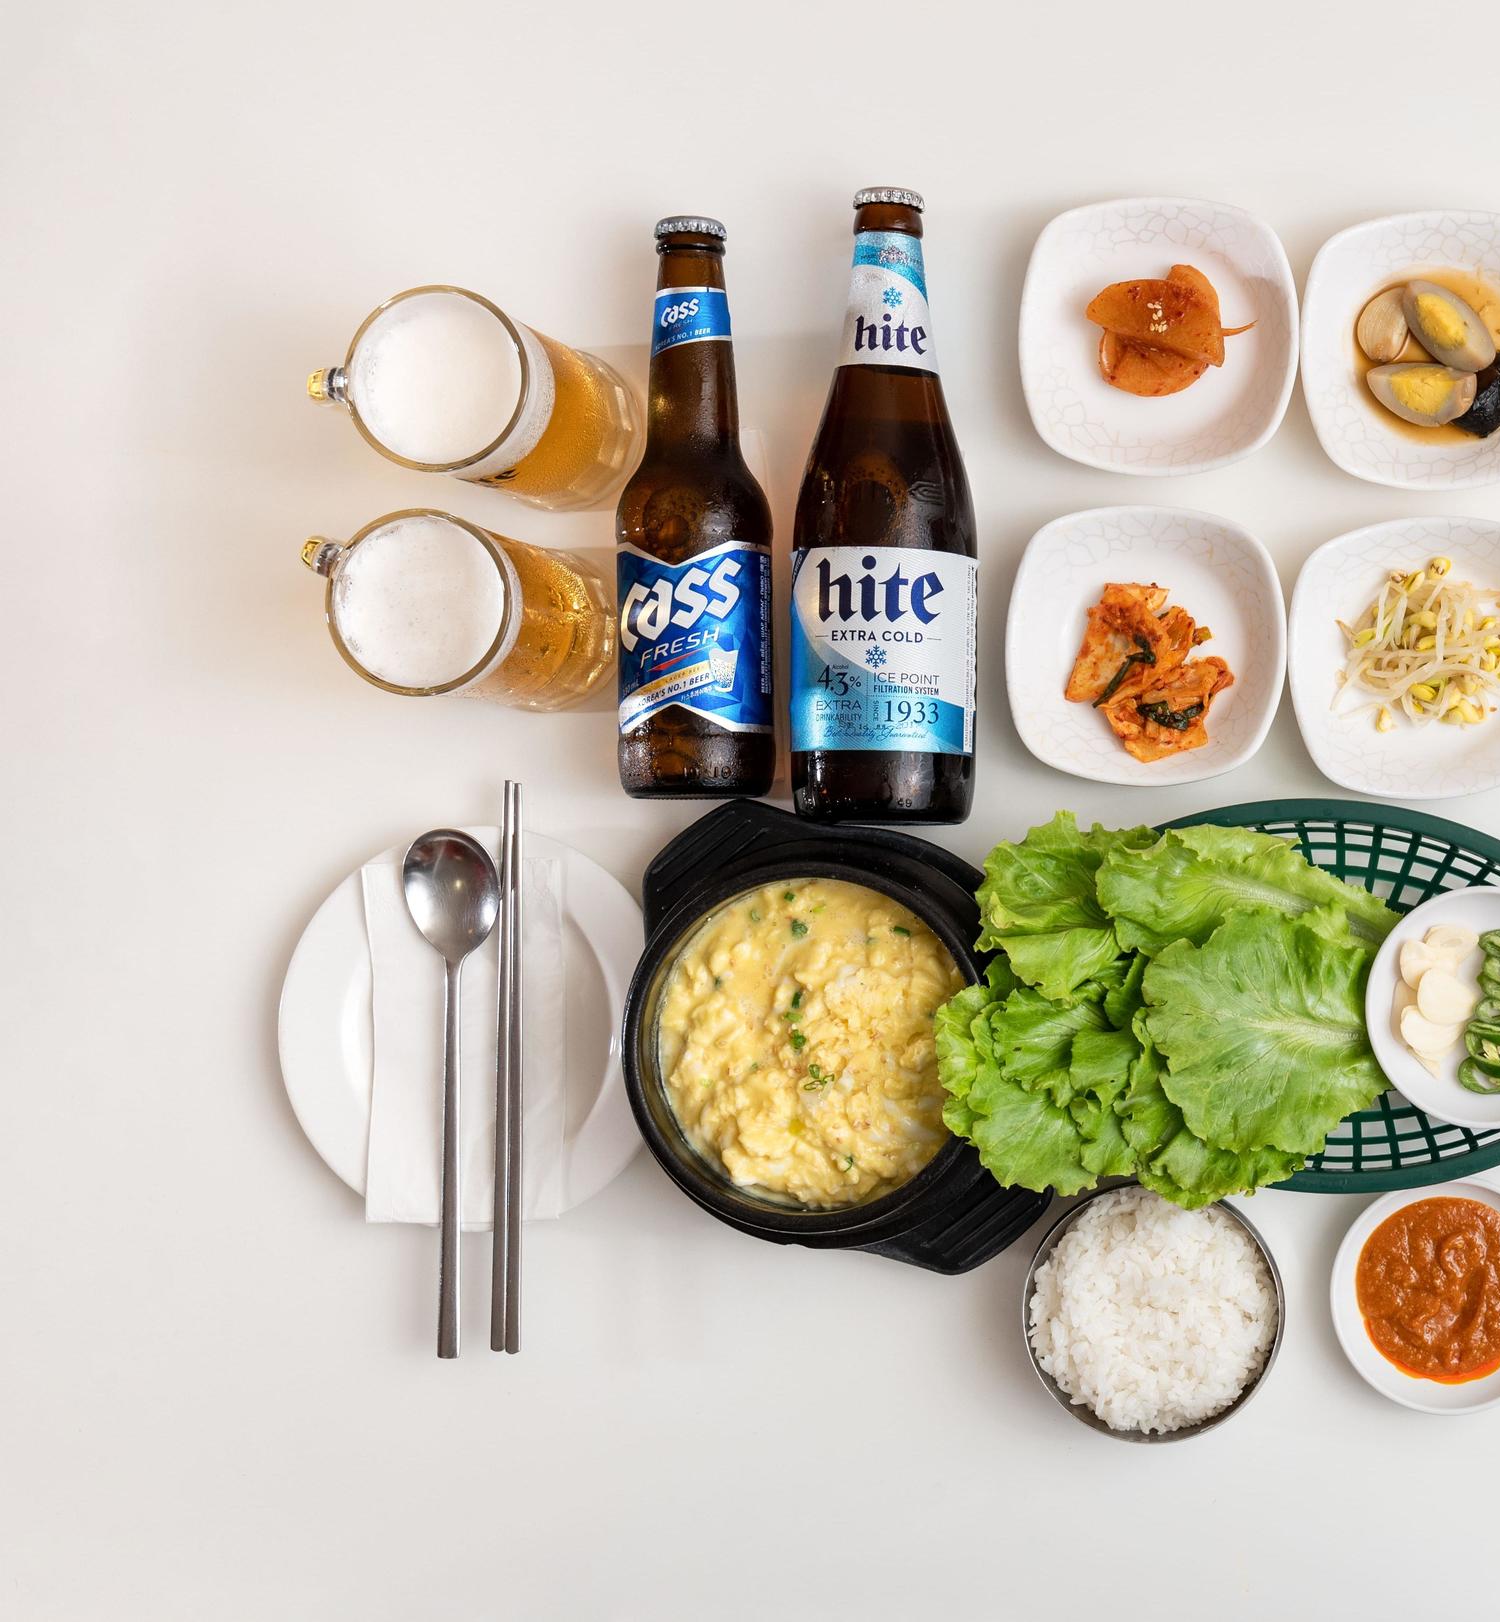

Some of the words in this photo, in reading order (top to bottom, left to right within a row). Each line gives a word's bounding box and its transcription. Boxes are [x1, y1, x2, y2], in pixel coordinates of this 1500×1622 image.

[694, 327, 711, 336] BEER
[854, 313, 928, 355] hite
[816, 554, 945, 625] hite
[831, 630, 877, 642] EXTRA
[882, 630, 923, 644] COLD
[639, 626, 720, 669] FRESH
[689, 672, 710, 686] BEER
[873, 672, 896, 683] ICE
[900, 673, 940, 686] POINT
[873, 685, 913, 694] FILTRATION
[915, 686, 940, 696] SYSTEM
[816, 700, 862, 710] EXTRA
[884, 700, 940, 724] 1933
[815, 713, 862, 722] DRINKABILITY
